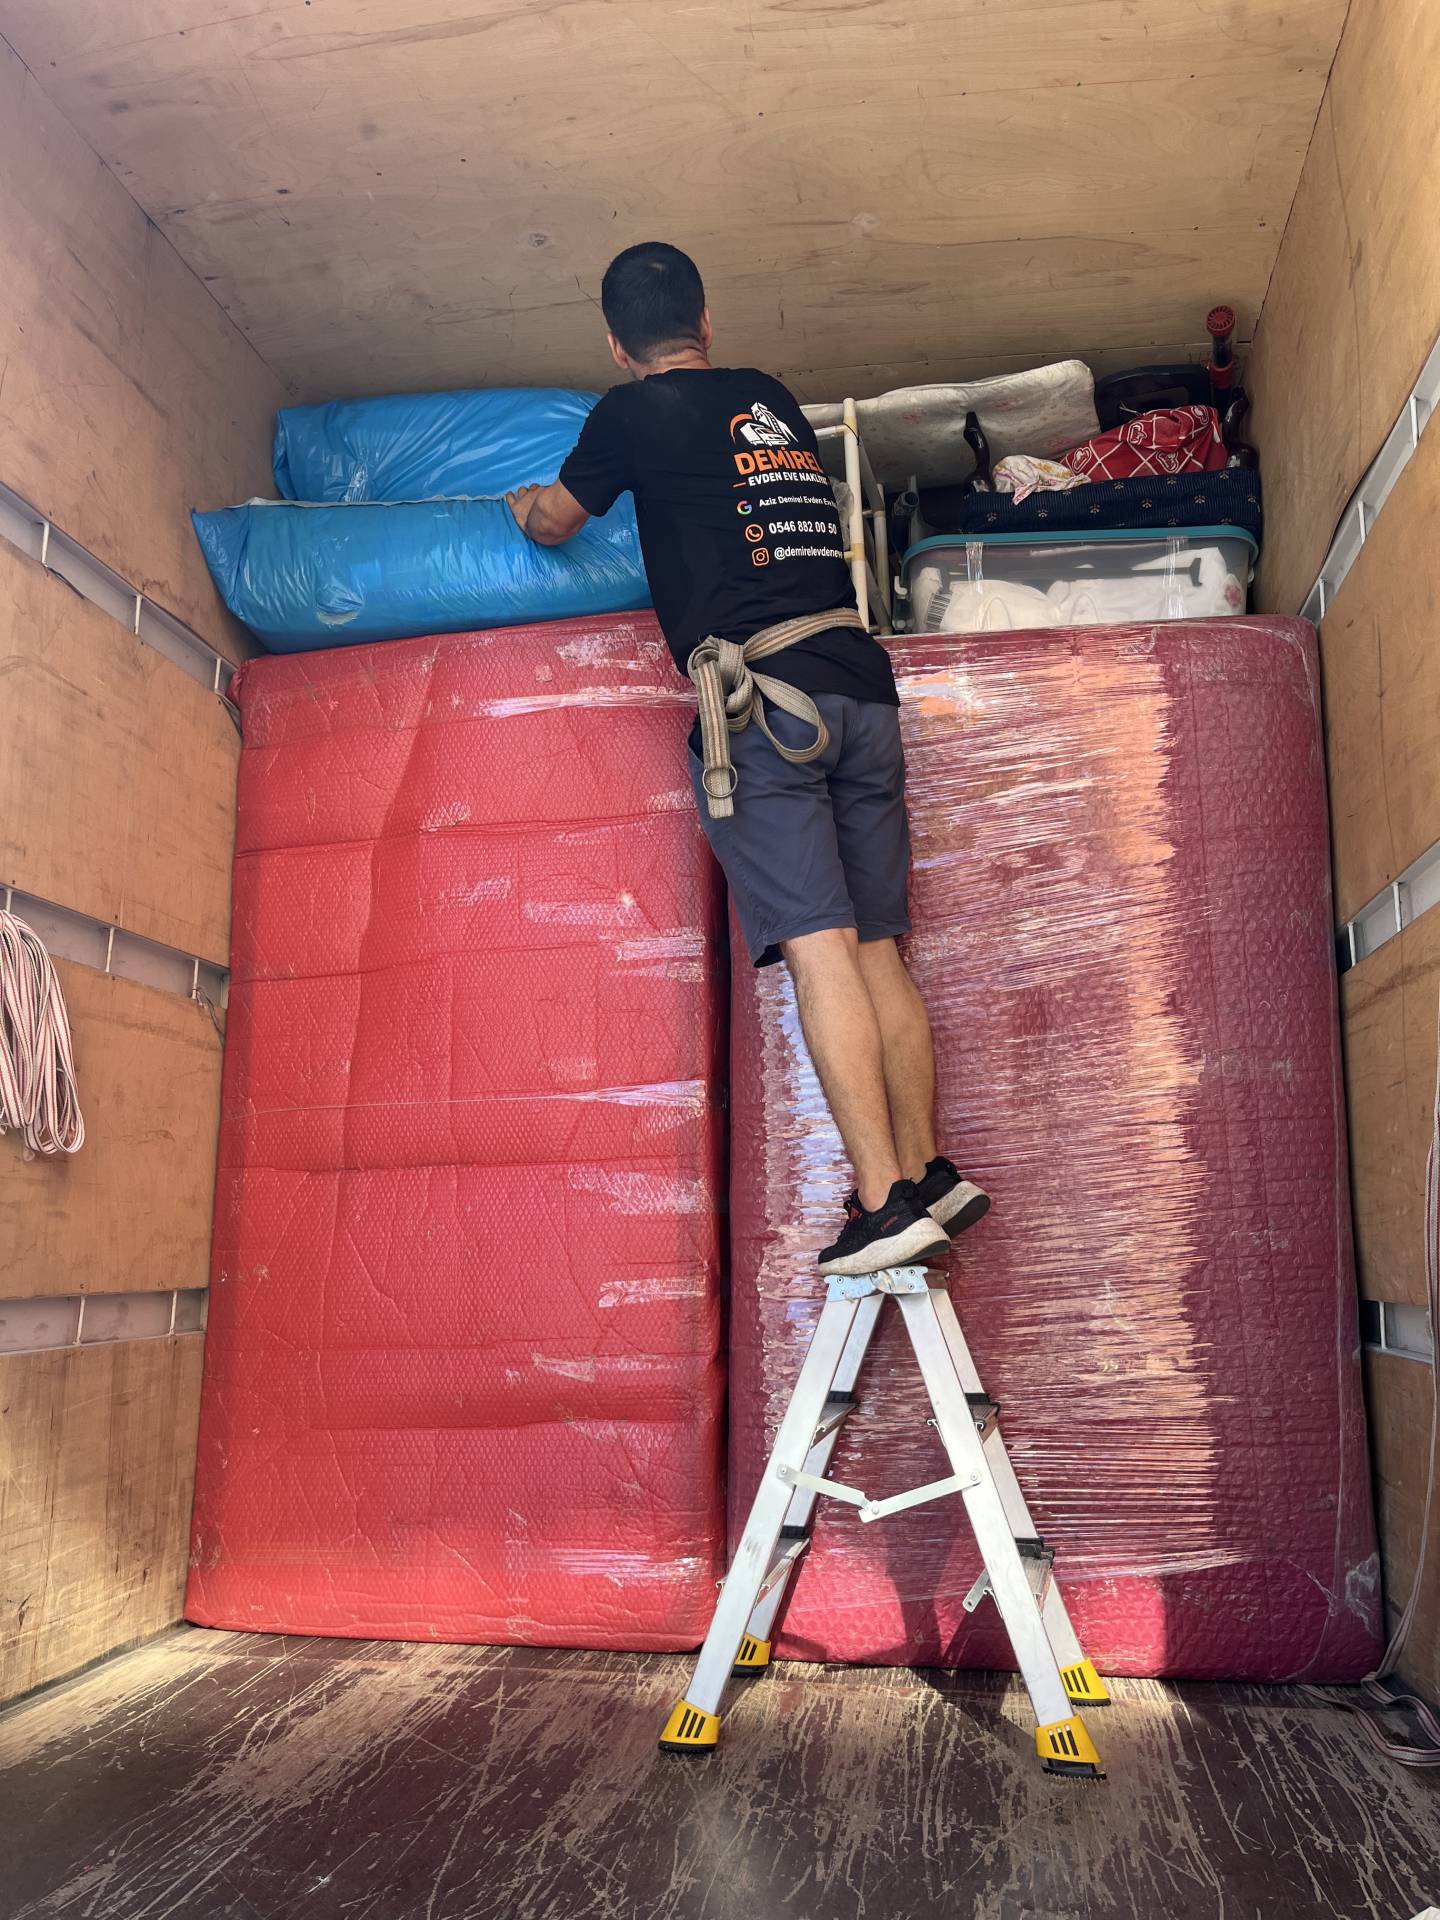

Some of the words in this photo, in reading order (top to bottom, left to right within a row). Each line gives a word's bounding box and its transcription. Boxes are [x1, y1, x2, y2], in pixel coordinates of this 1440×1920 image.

[748, 471, 783, 487] EVDEN
[783, 472, 799, 481] EVE
[737, 500, 752, 515] G
[759, 498, 777, 507] Aziz
[777, 496, 803, 504] Demirel
[803, 496, 823, 505] Evden
[768, 521, 797, 534] 0546
[797, 521, 813, 533] 882
[814, 521, 826, 533] 00
